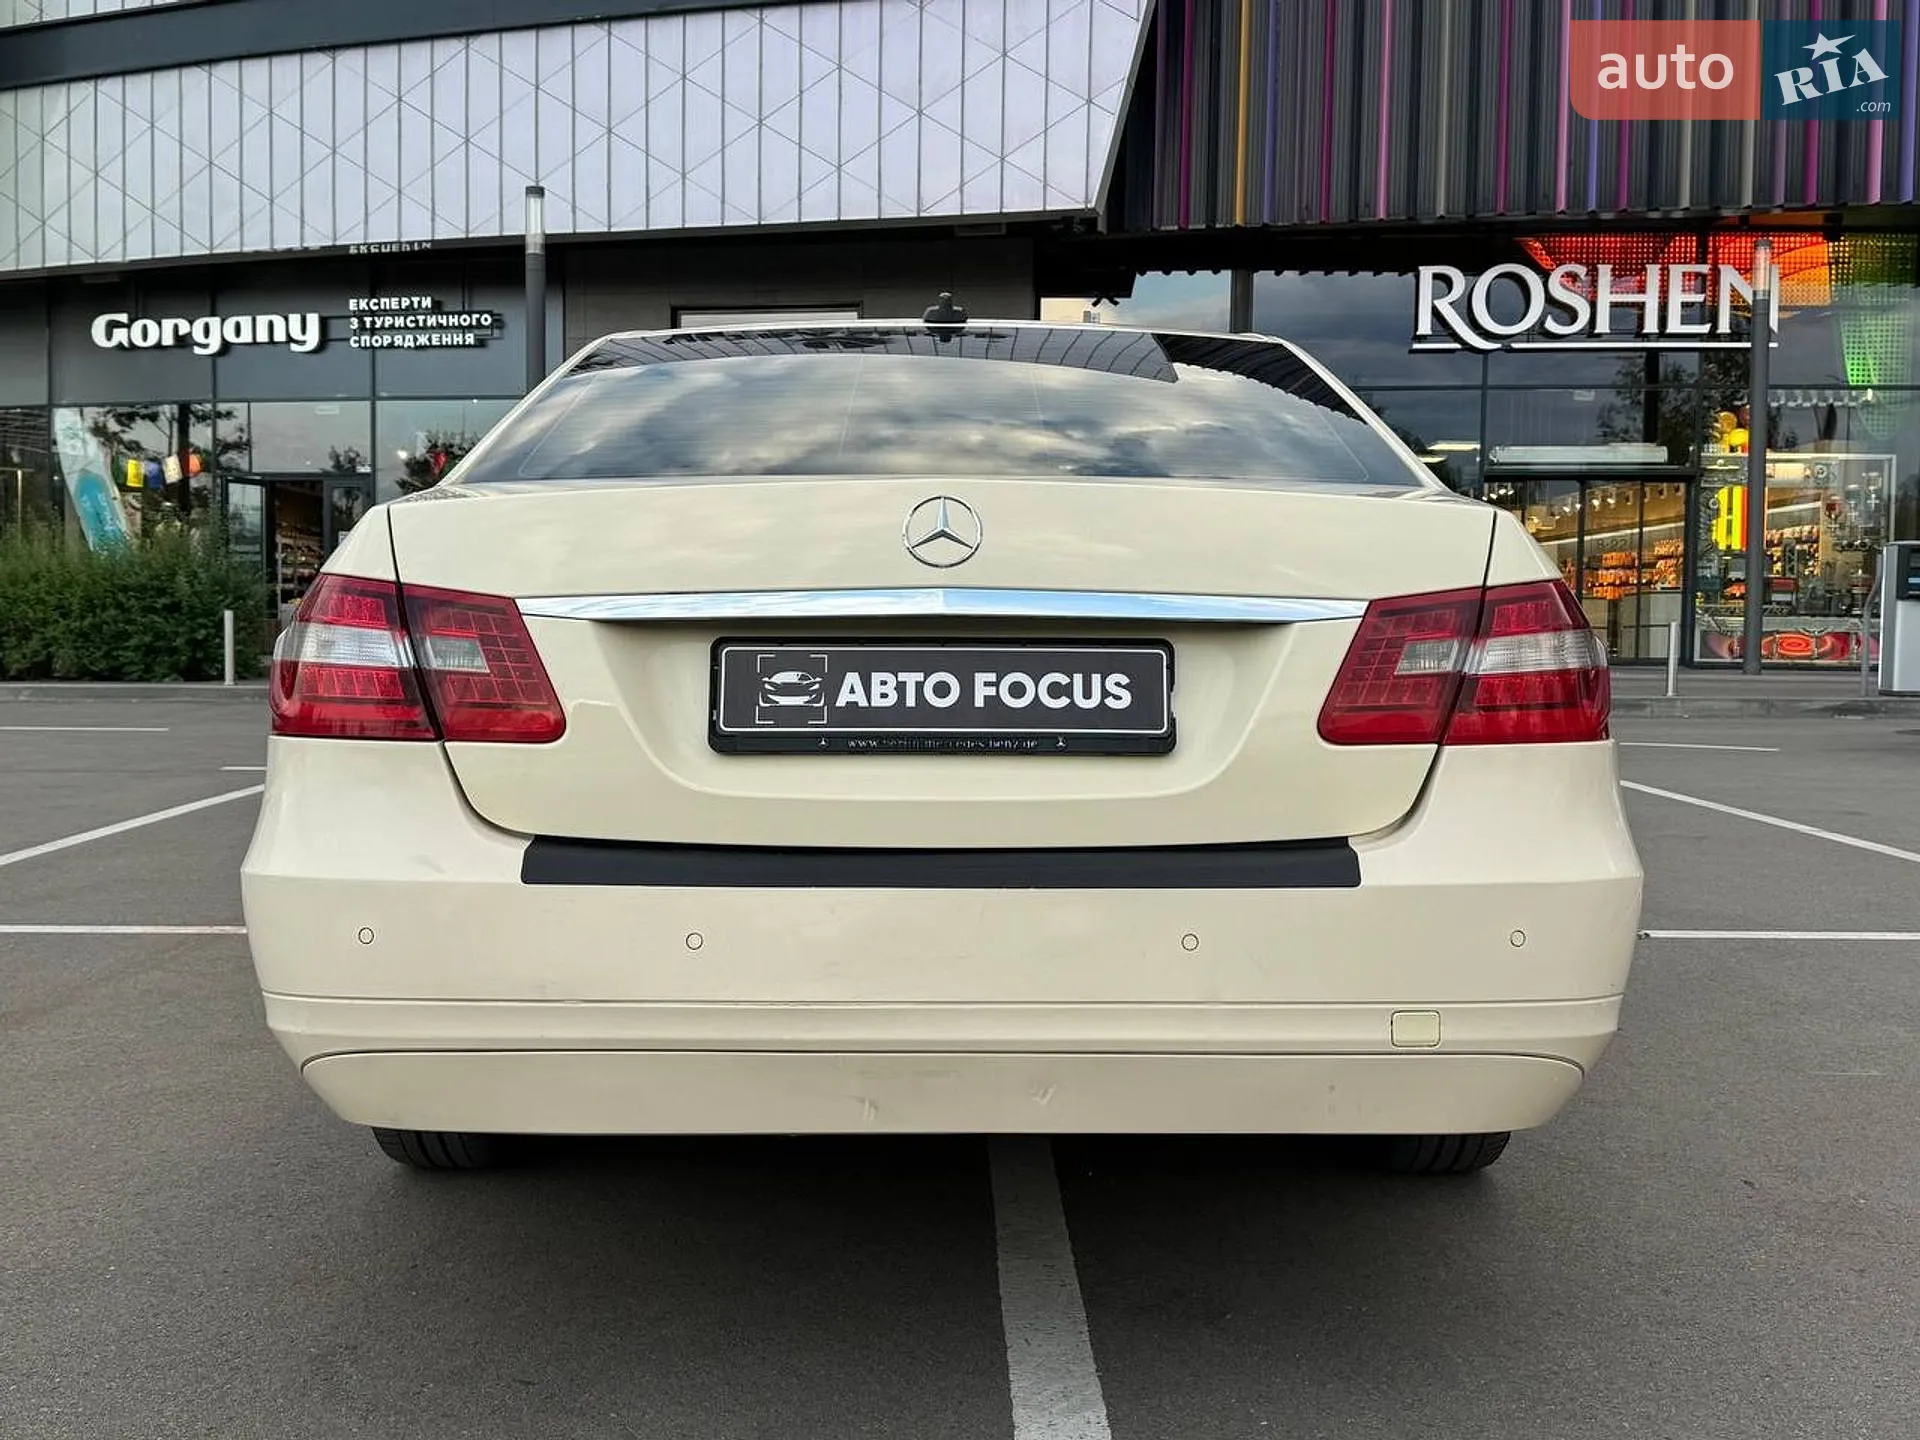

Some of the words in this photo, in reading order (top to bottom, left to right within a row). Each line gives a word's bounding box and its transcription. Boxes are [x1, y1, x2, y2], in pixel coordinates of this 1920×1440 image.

[349, 296, 432, 311] ЕКСПЕРТИ
[1412, 262, 1780, 350] ROSHEN
[91, 312, 320, 356] Gorgany
[364, 314, 493, 330] ТУРИСТИЧНОГО
[350, 333, 475, 349] СПОРЯДЖЕННЯ
[973, 671, 1132, 710] FOCUS
